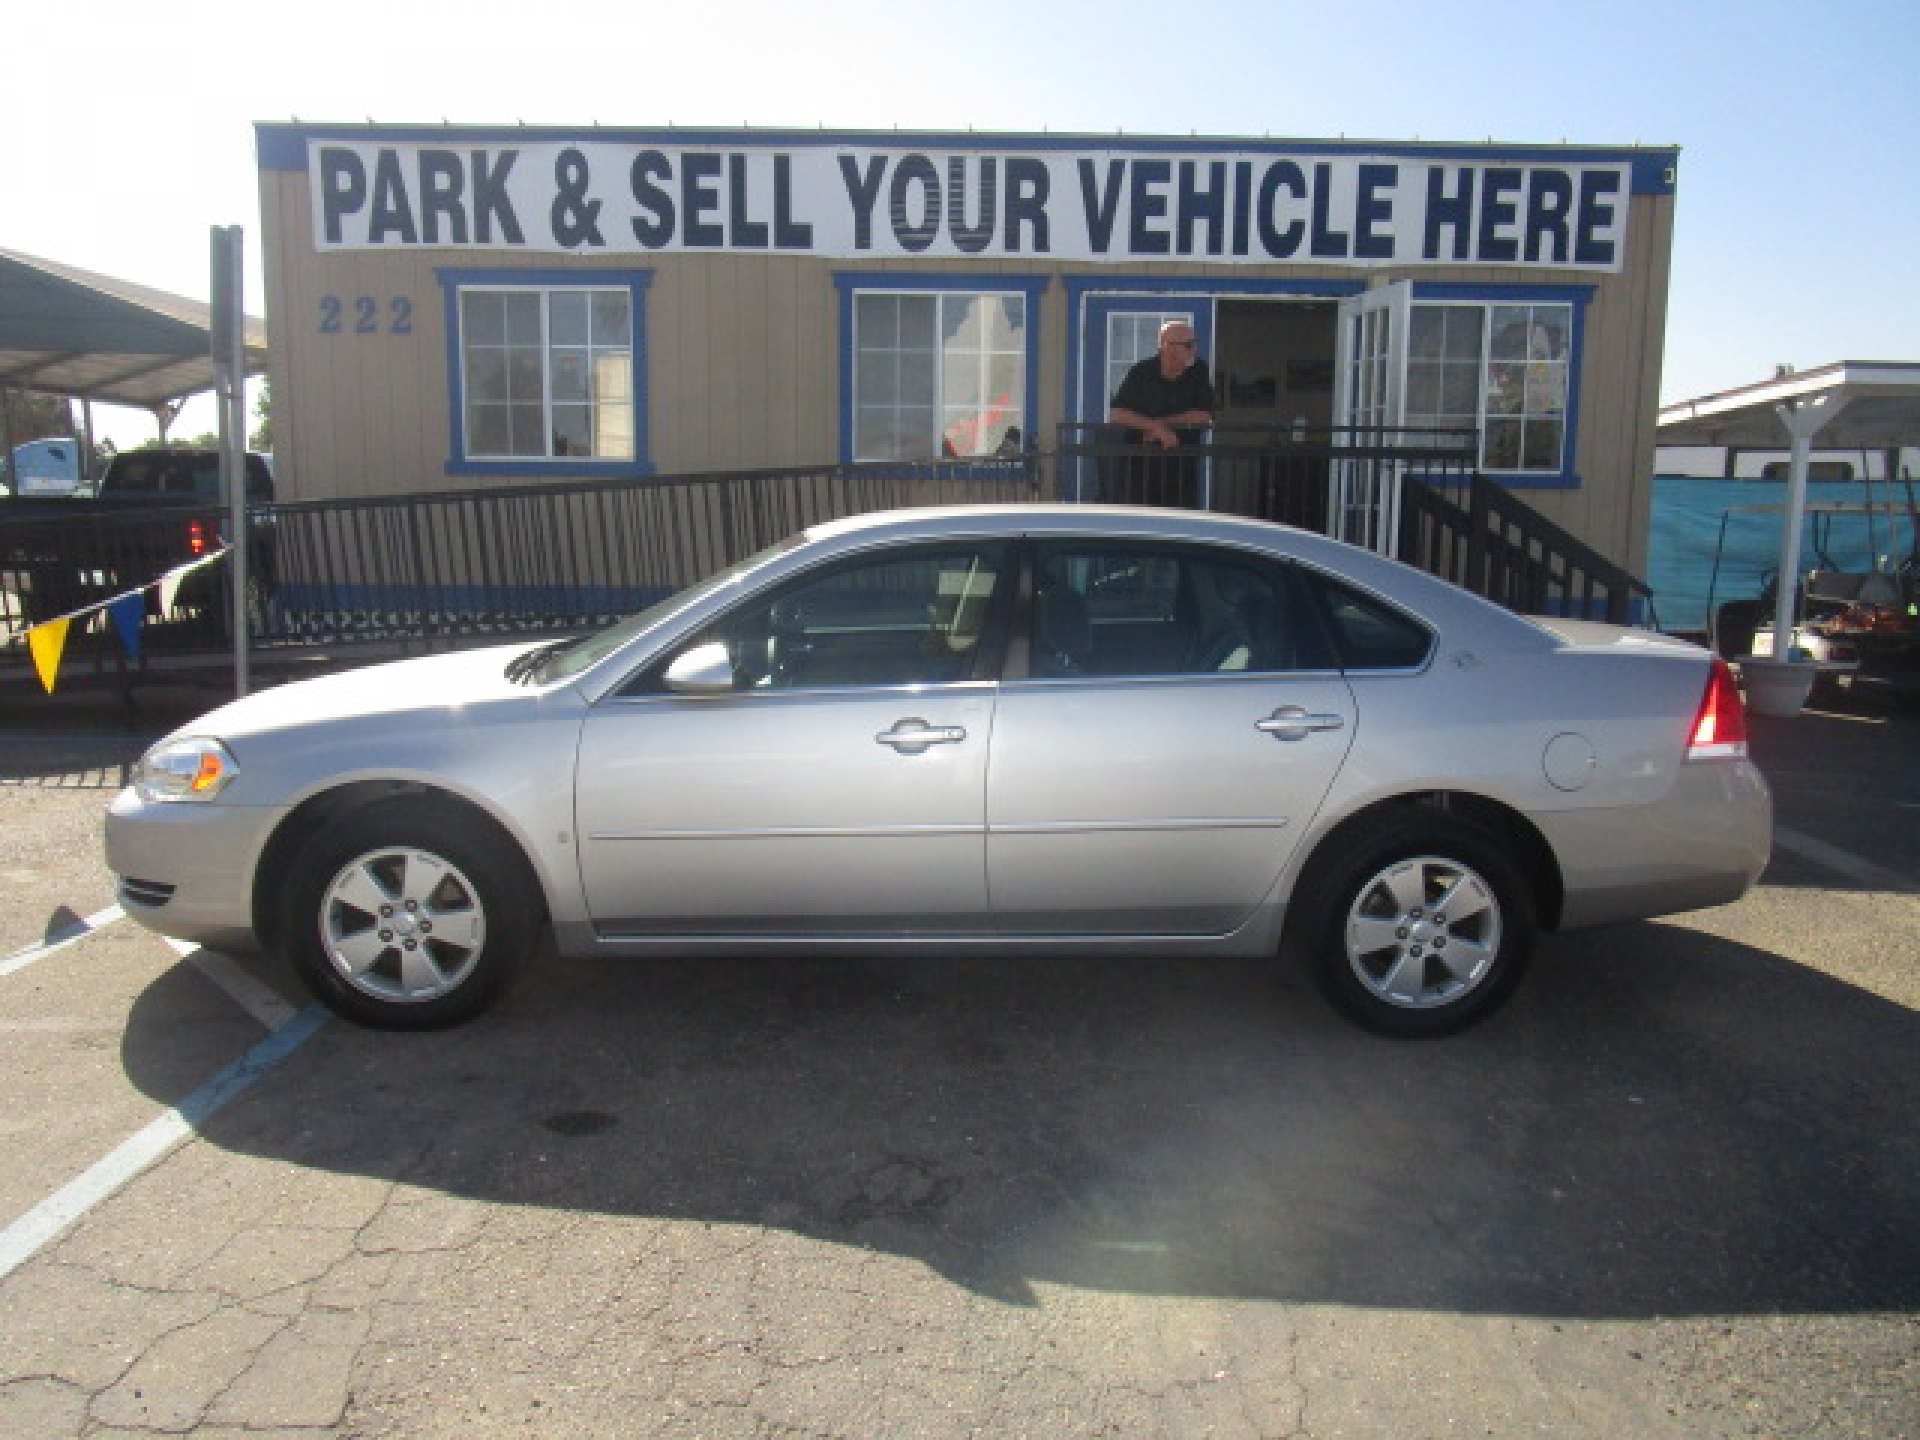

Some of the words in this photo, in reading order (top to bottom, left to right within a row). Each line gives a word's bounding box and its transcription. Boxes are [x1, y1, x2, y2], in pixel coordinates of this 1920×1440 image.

[319, 147, 525, 245] PARK
[551, 147, 605, 248] &
[630, 148, 813, 249] SELL
[838, 153, 1051, 254] YOUR
[1077, 157, 1398, 260] VEHICLE
[1422, 165, 1621, 265] HERE
[318, 295, 414, 334] 222
